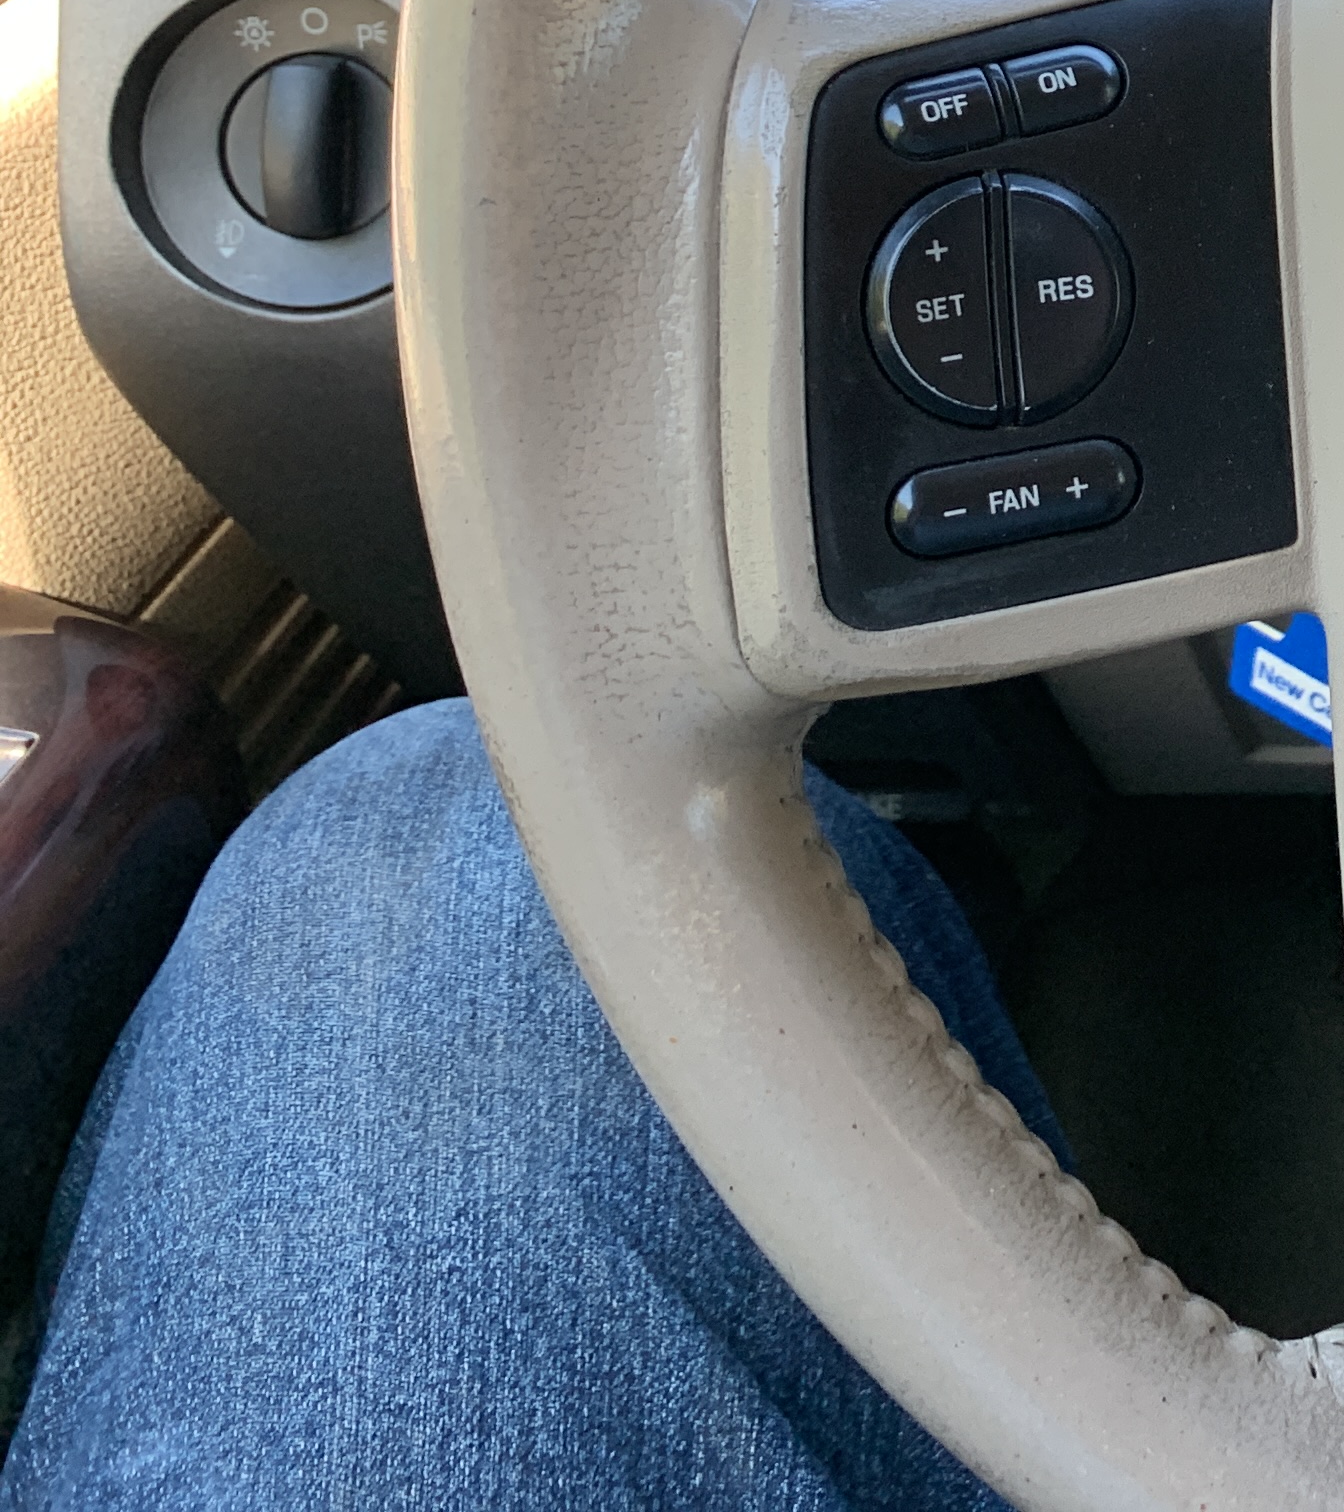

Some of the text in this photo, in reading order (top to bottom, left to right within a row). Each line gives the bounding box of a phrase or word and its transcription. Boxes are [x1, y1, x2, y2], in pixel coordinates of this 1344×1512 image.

[1037, 66, 1078, 94] ON
[919, 92, 969, 123] OFF
[1037, 274, 1095, 305] RES
[915, 294, 965, 324] SET
[988, 485, 1041, 515] FAN
[1259, 661, 1305, 700] New
